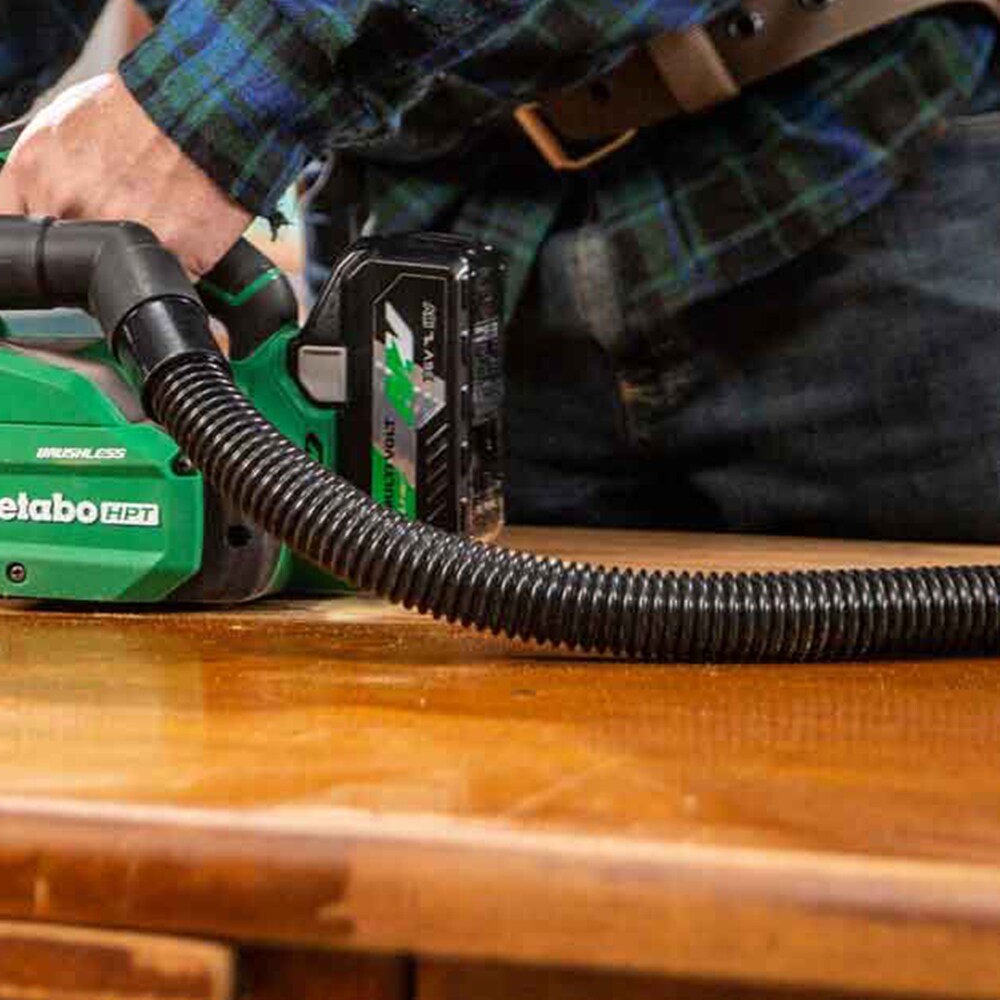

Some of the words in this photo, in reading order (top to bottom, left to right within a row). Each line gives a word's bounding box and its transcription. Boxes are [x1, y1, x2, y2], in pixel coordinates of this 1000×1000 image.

[382, 420, 395, 460] VOLT
[36, 446, 127, 460] BRUSHLESS
[102, 503, 158, 525] HPT
